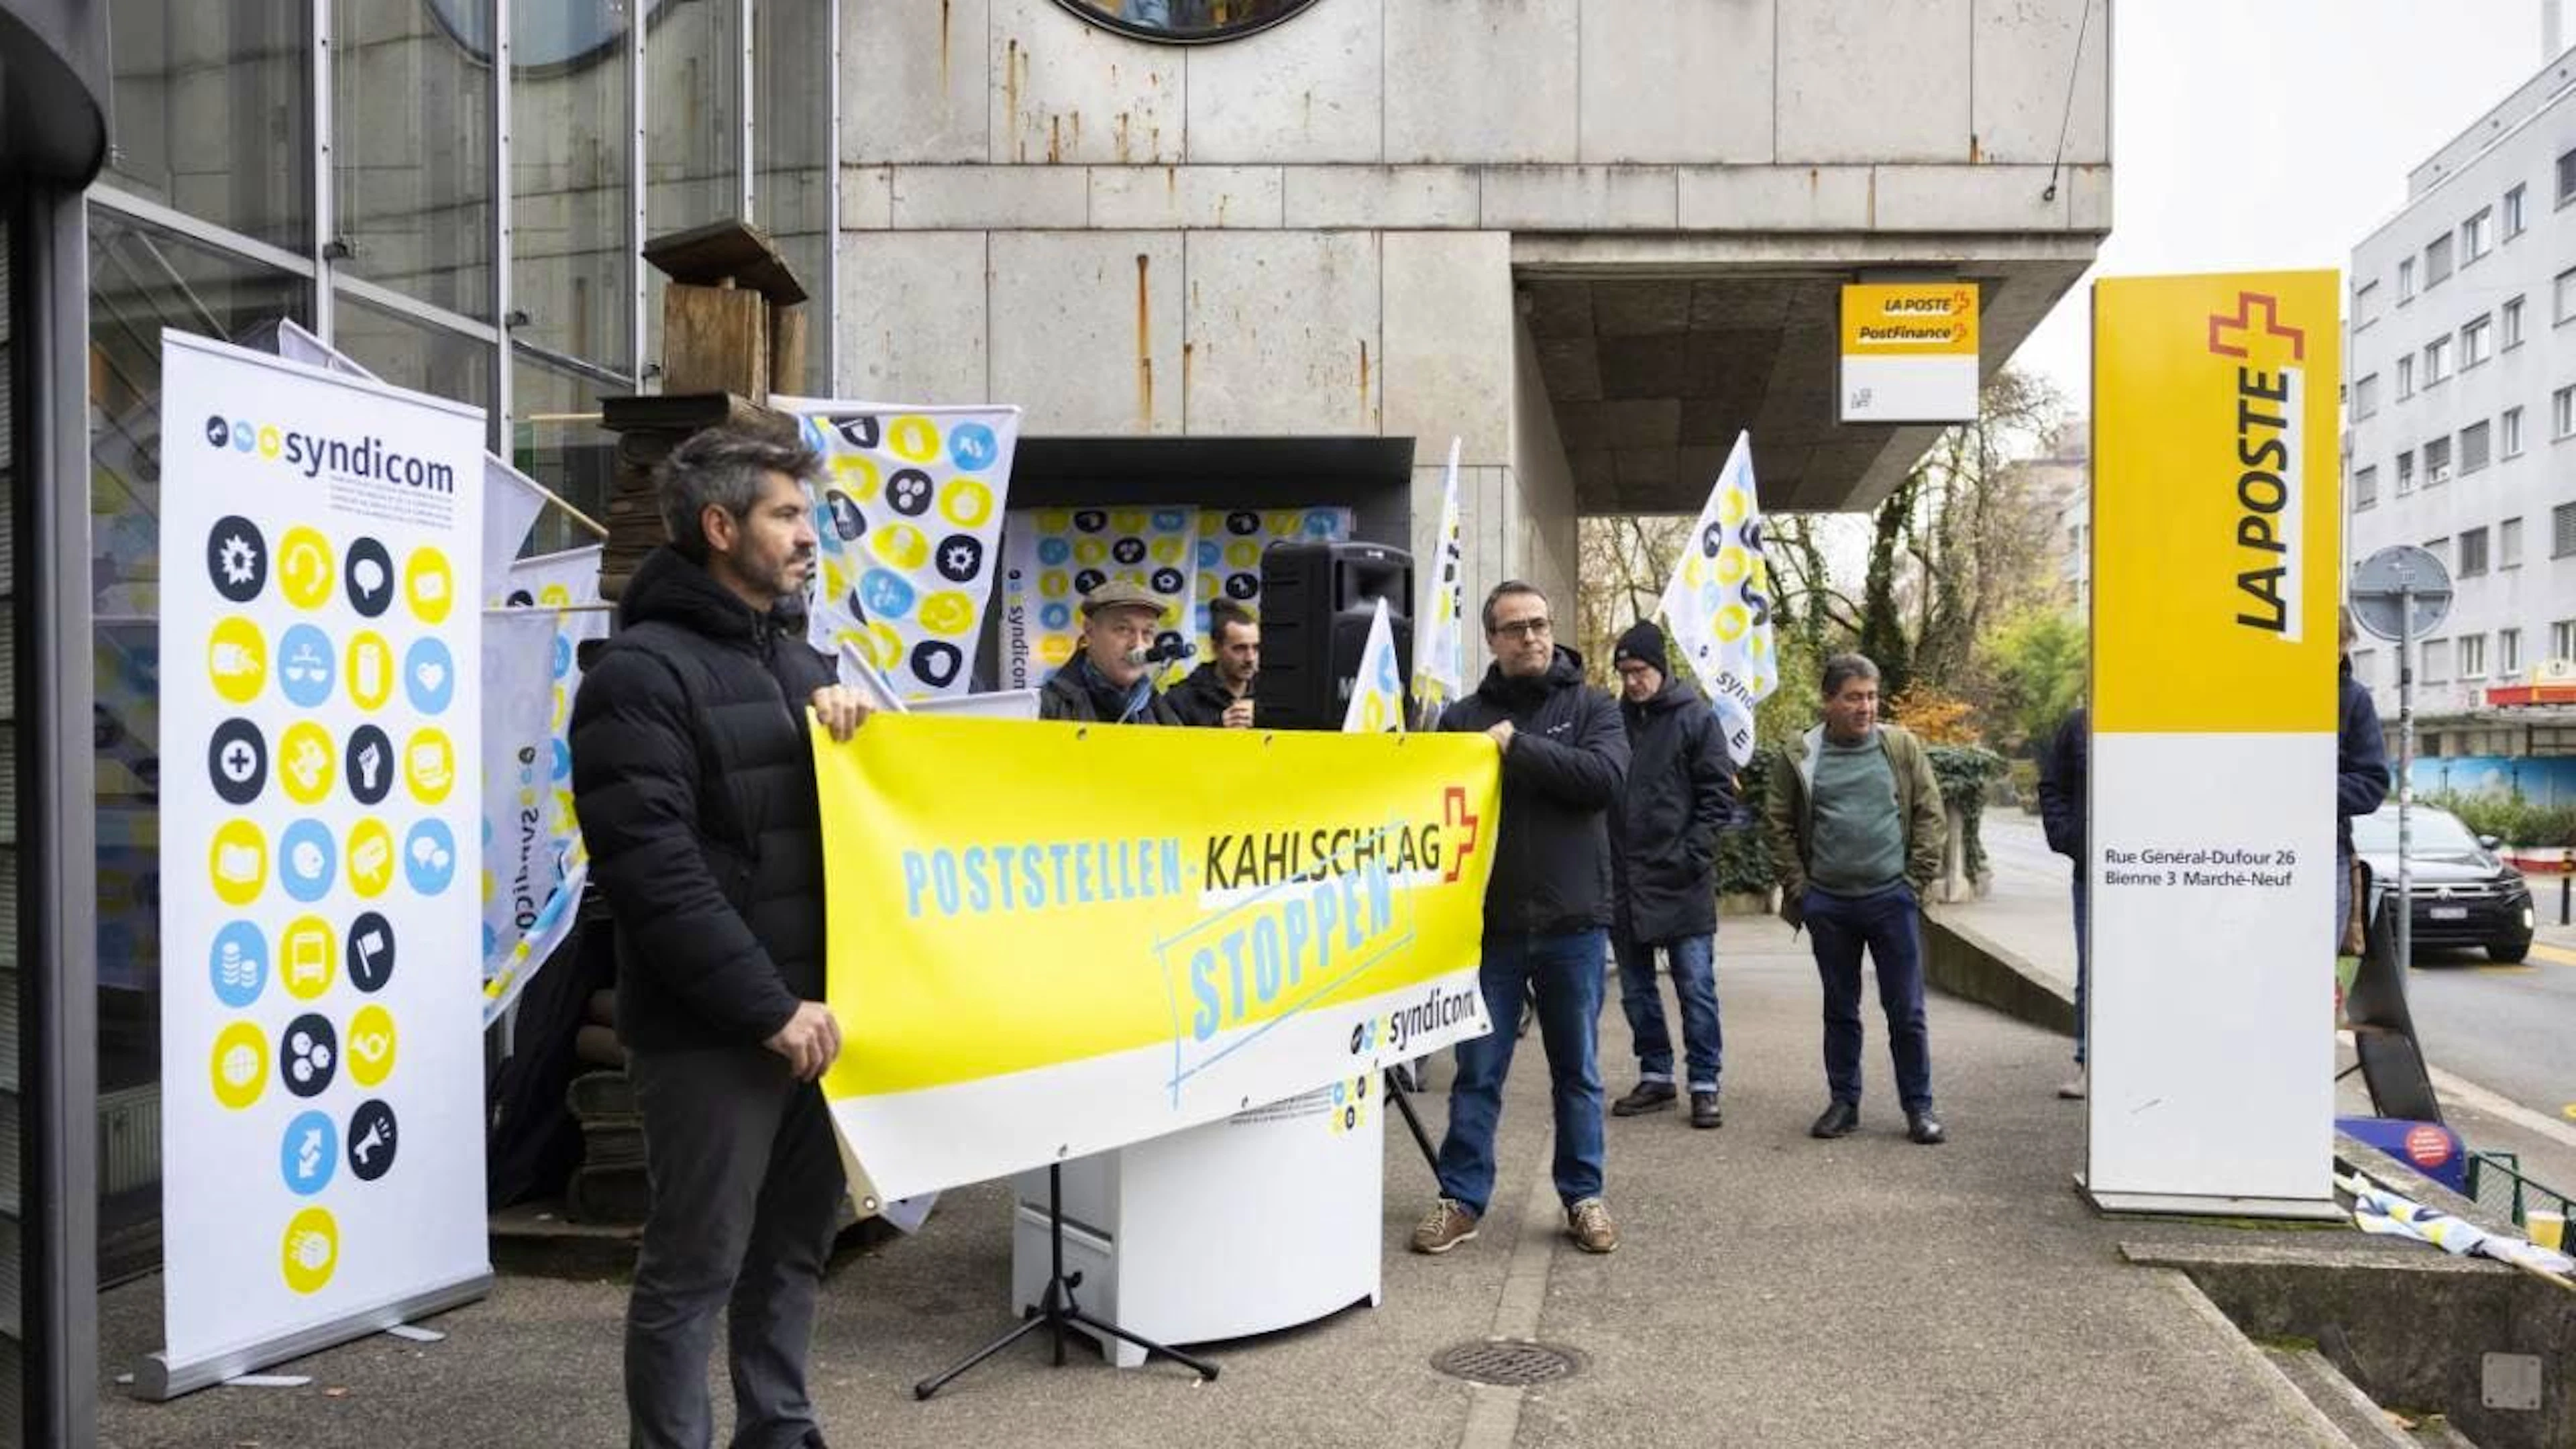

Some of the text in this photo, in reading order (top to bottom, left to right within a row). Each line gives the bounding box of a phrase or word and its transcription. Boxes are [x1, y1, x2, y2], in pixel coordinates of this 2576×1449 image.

[1860, 325, 1951, 339] PostFinance
[1885, 299, 1951, 311] LA POSTE
[286, 433, 453, 494] syndicom
[2237, 366, 2289, 633] LA POSTE
[1205, 823, 1441, 892] KAHLSCHLAG
[2106, 849, 2296, 865] Rue Général-Dufour 26
[2106, 871, 2293, 885] Bienne 3 Marché-Neuf
[1189, 857, 1393, 1042] STOPPEN
[1389, 987, 1474, 1051] syndicom
